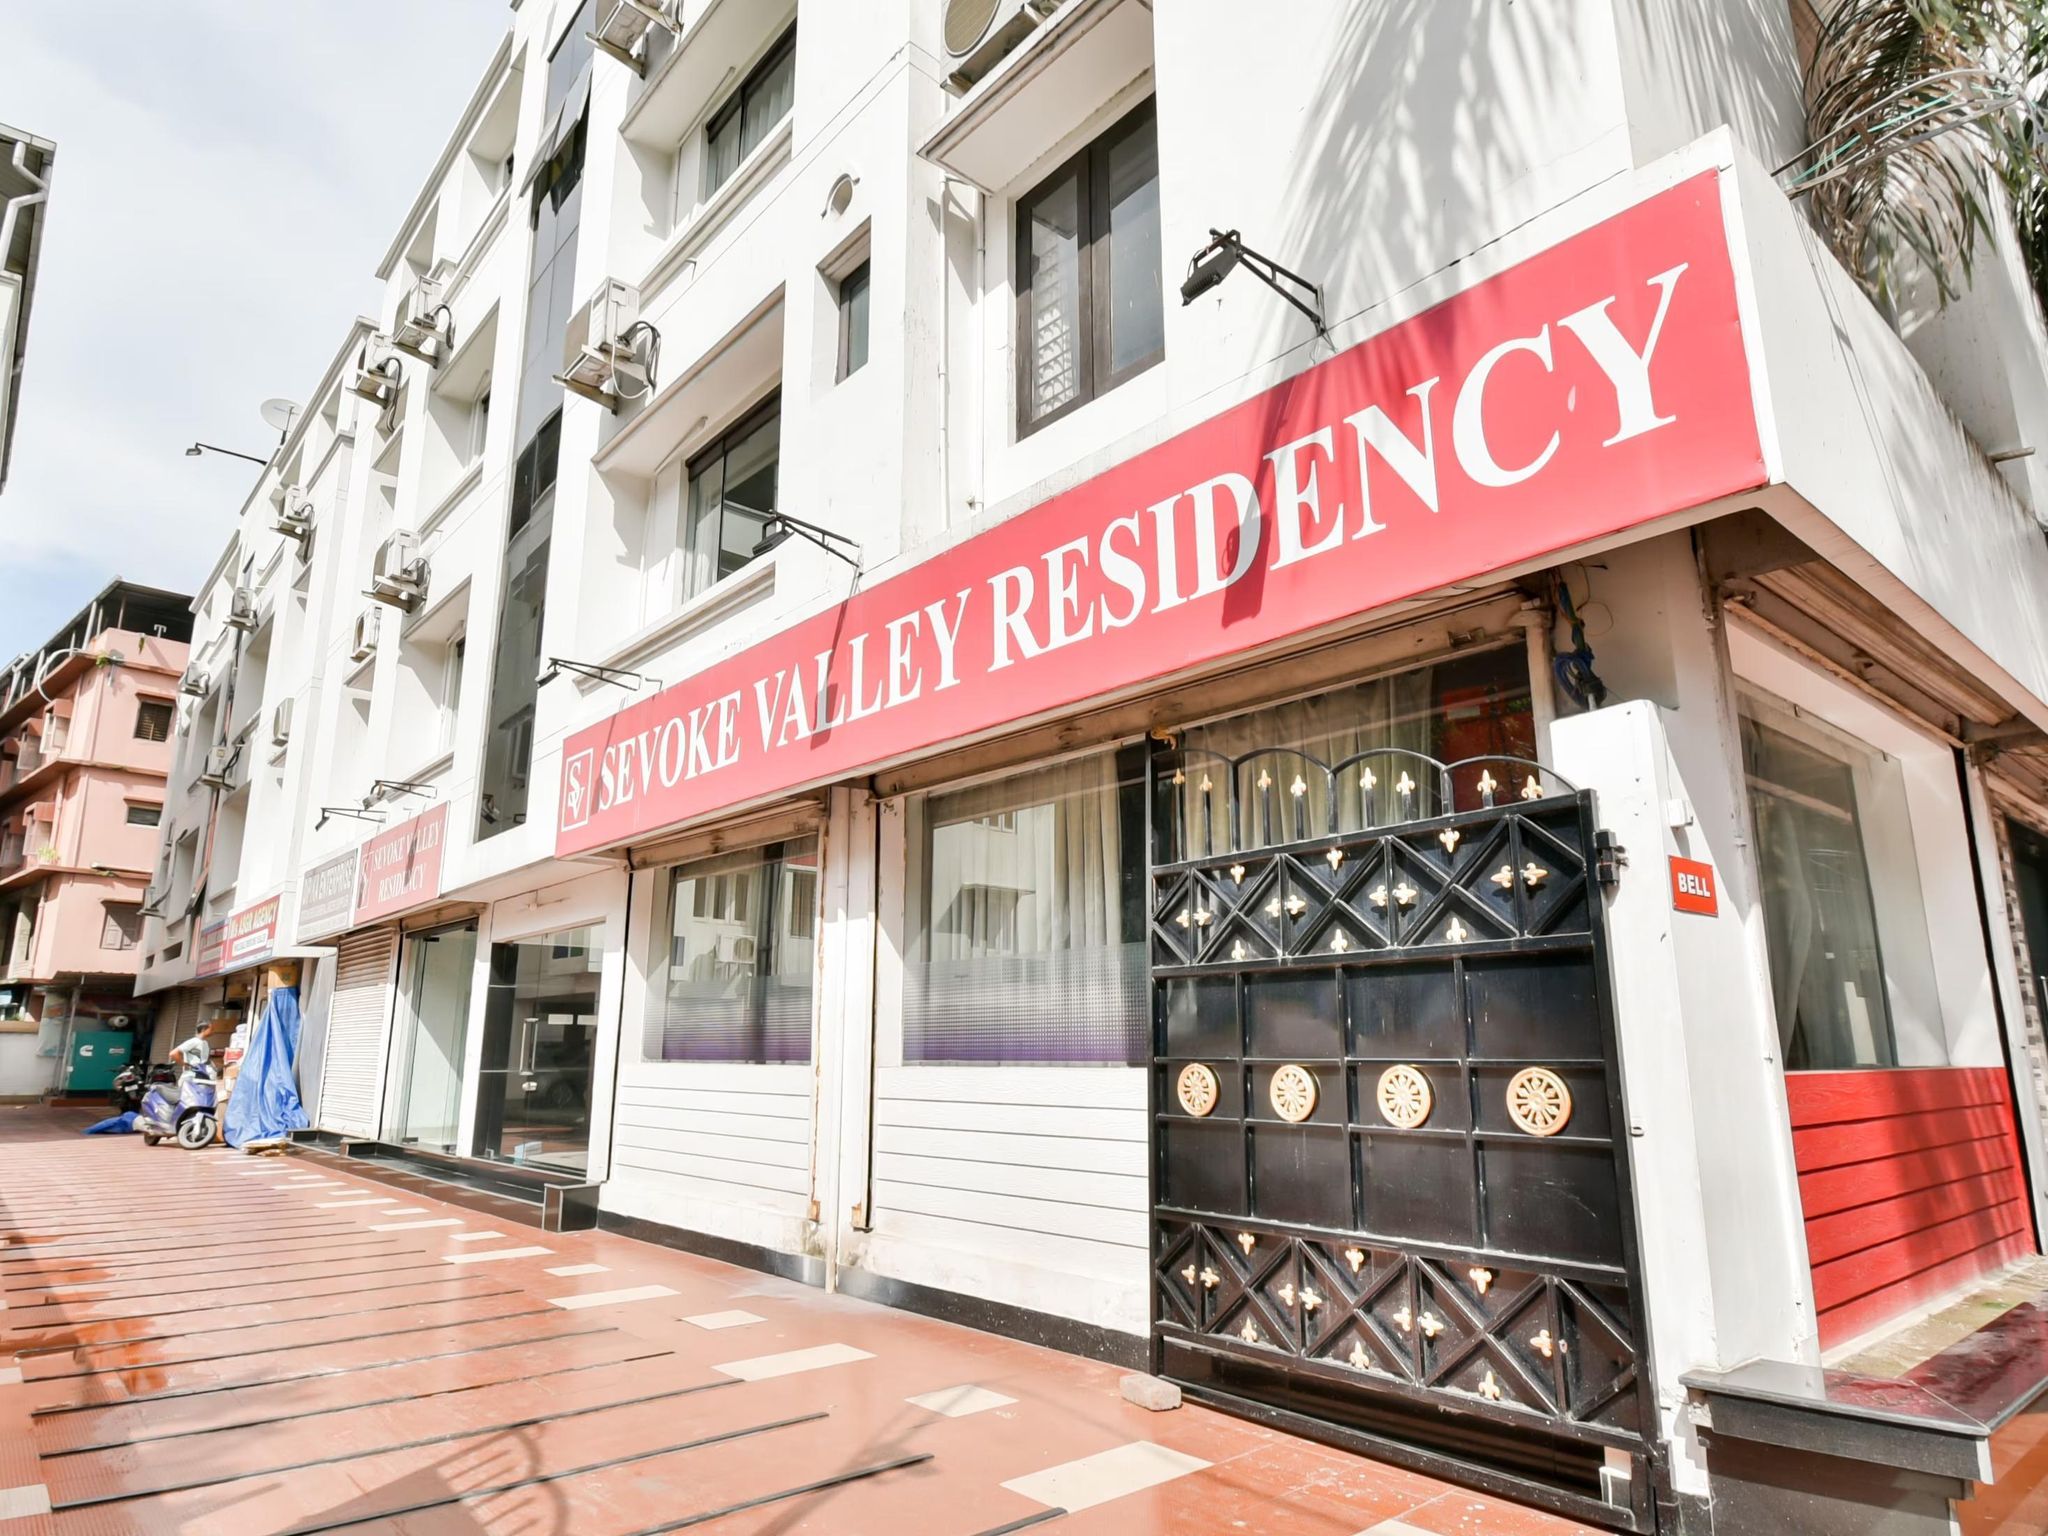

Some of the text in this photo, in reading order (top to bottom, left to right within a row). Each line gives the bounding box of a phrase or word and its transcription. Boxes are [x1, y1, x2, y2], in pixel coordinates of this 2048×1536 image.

[598, 261, 1689, 812] SEVOKE VALLEY RESIDENCY
[373, 819, 442, 872] SEVOKE VALLEY
[378, 862, 427, 904] RESIDENCY
[1677, 872, 1711, 897] BELL
